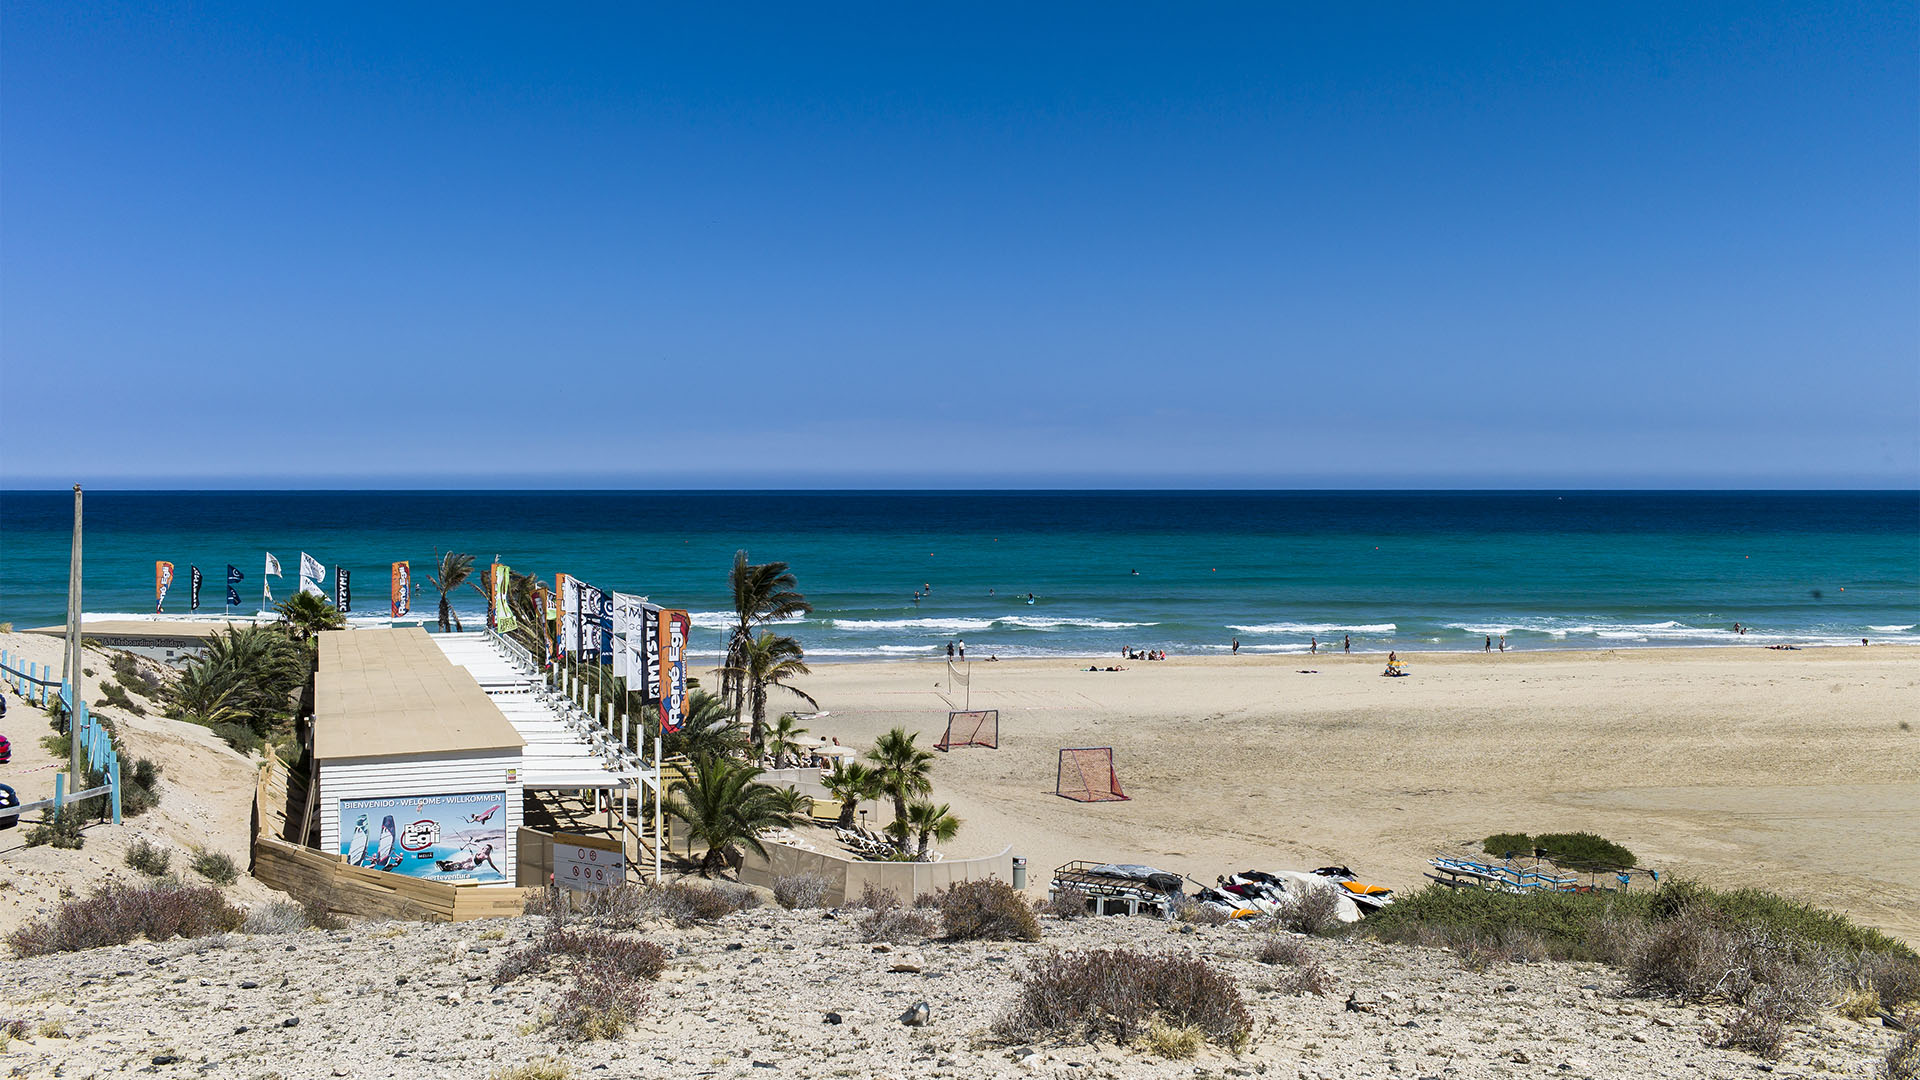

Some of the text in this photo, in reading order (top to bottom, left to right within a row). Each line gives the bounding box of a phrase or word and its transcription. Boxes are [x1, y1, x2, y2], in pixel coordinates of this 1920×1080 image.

[161, 566, 170, 585] Egli
[398, 567, 408, 614] René Egli
[110, 638, 154, 649] Kiteboarding
[155, 639, 186, 650] Holidays
[668, 621, 684, 726] René Egli
[344, 794, 502, 809] BIENVENIDO WELCOME WILLKOMMEN
[404, 822, 440, 832] René
[405, 832, 440, 847] Egli
